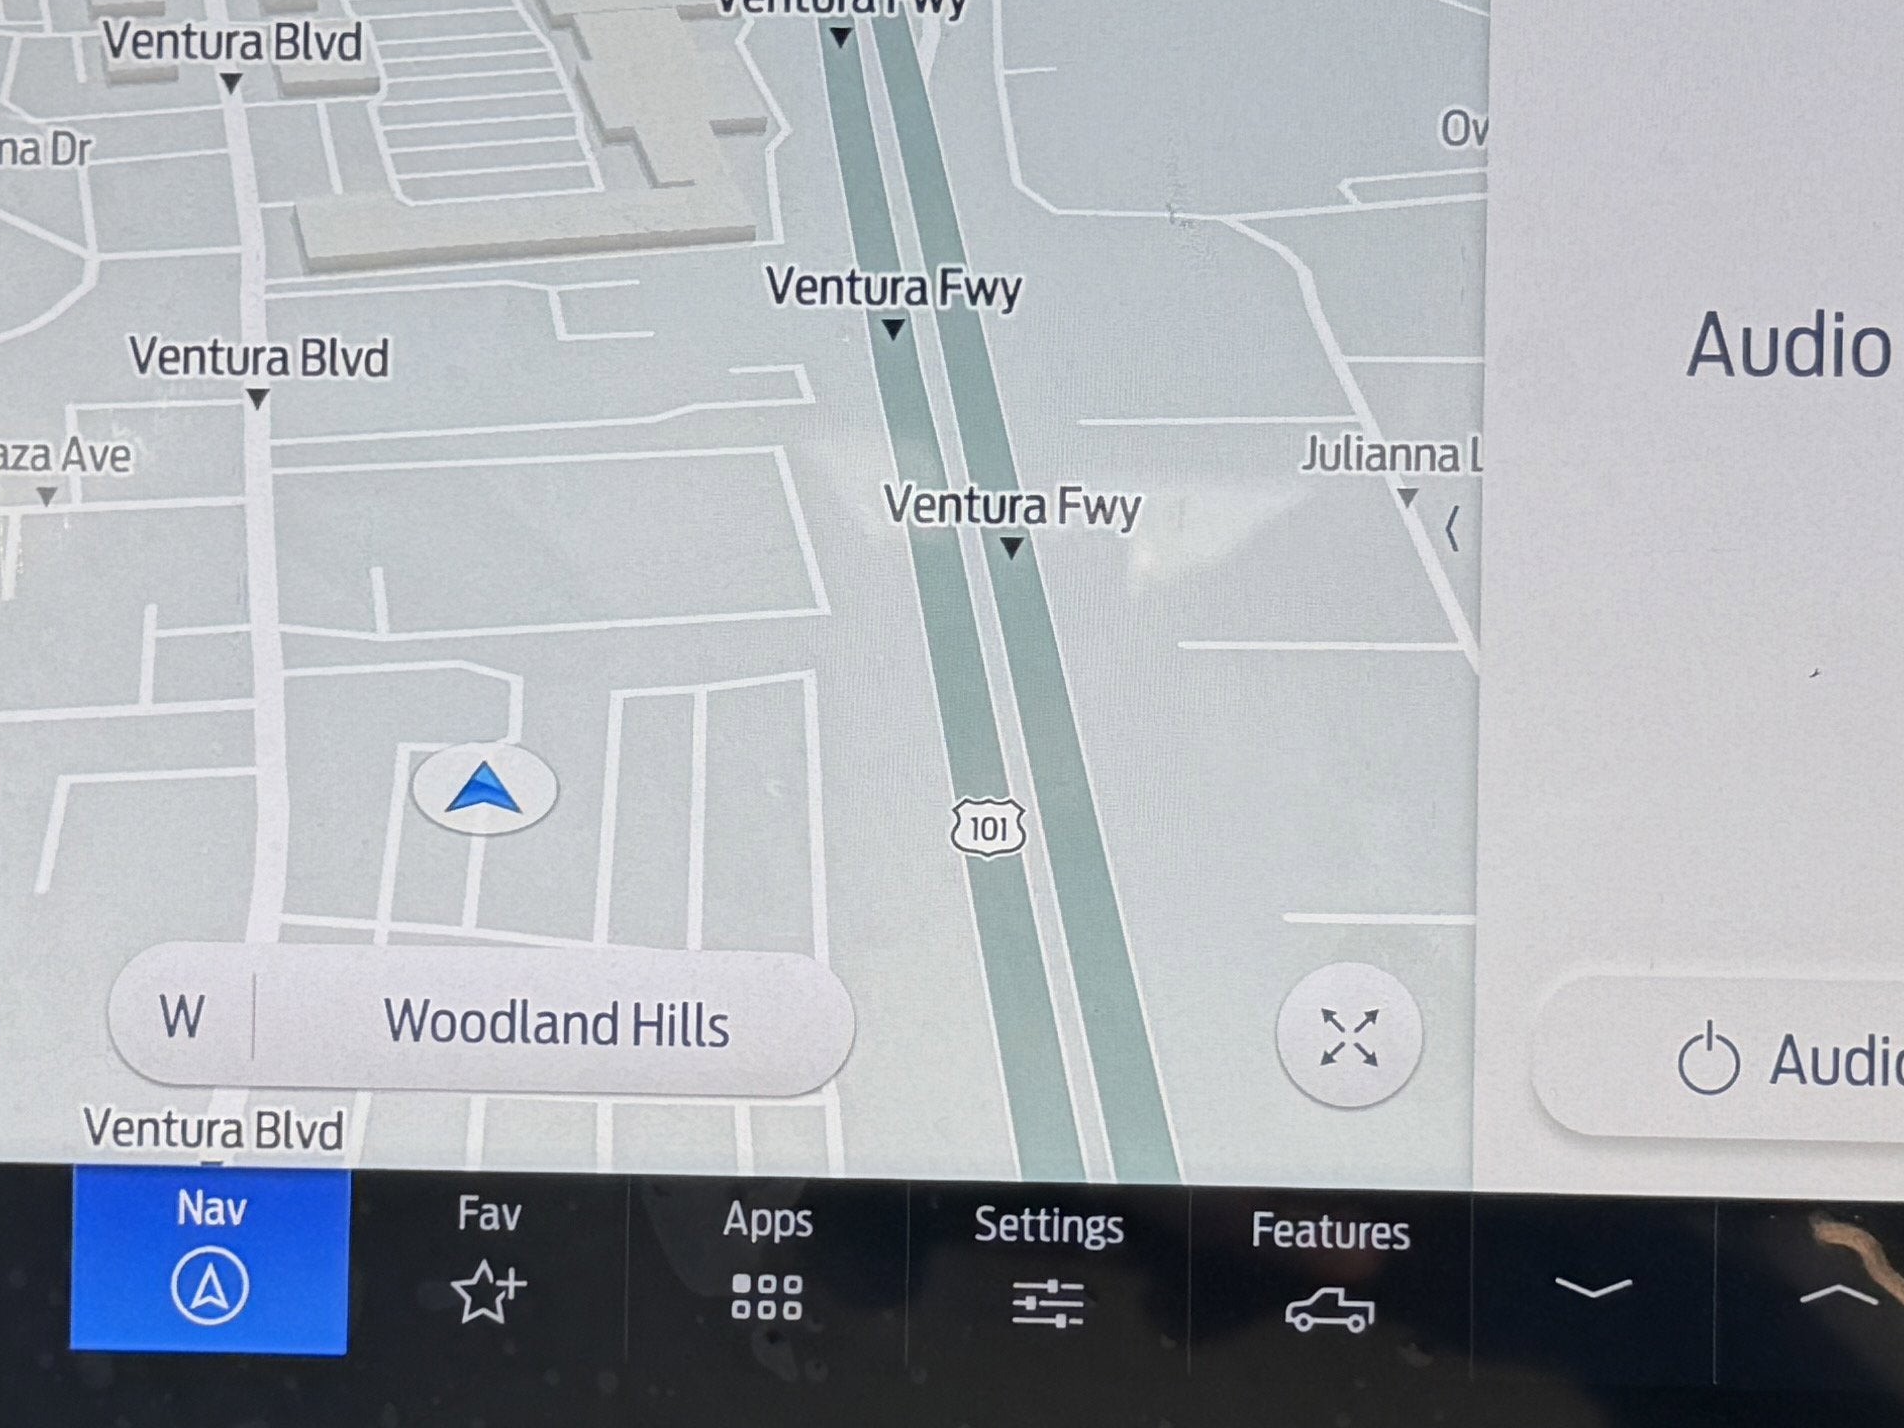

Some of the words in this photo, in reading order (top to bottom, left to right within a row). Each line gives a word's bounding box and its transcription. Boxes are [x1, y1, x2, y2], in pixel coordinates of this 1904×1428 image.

[103, 21, 263, 60] Ventura
[275, 21, 363, 61] Blvd
[52, 132, 92, 167] Dr
[764, 266, 928, 305] Ventura
[939, 269, 1022, 313] Fwy
[130, 336, 289, 376] Ventura
[302, 338, 388, 377] Blvd
[1686, 310, 1893, 378] Audio
[62, 436, 130, 472] Ave
[1302, 434, 1460, 472] Julianna
[885, 484, 1045, 523] Ventura
[1059, 487, 1142, 532] Fwy
[971, 817, 1008, 842] 101
[160, 994, 204, 1038] W
[385, 997, 618, 1046] Woodland
[633, 1002, 731, 1048] Hills
[84, 1108, 243, 1149] Ventura
[256, 1110, 343, 1150] Blvd
[178, 1190, 247, 1226] Nav
[458, 1196, 522, 1230] Fav
[723, 1201, 814, 1243] Apps
[974, 1204, 1125, 1251] Settings
[1252, 1211, 1411, 1251] Features
